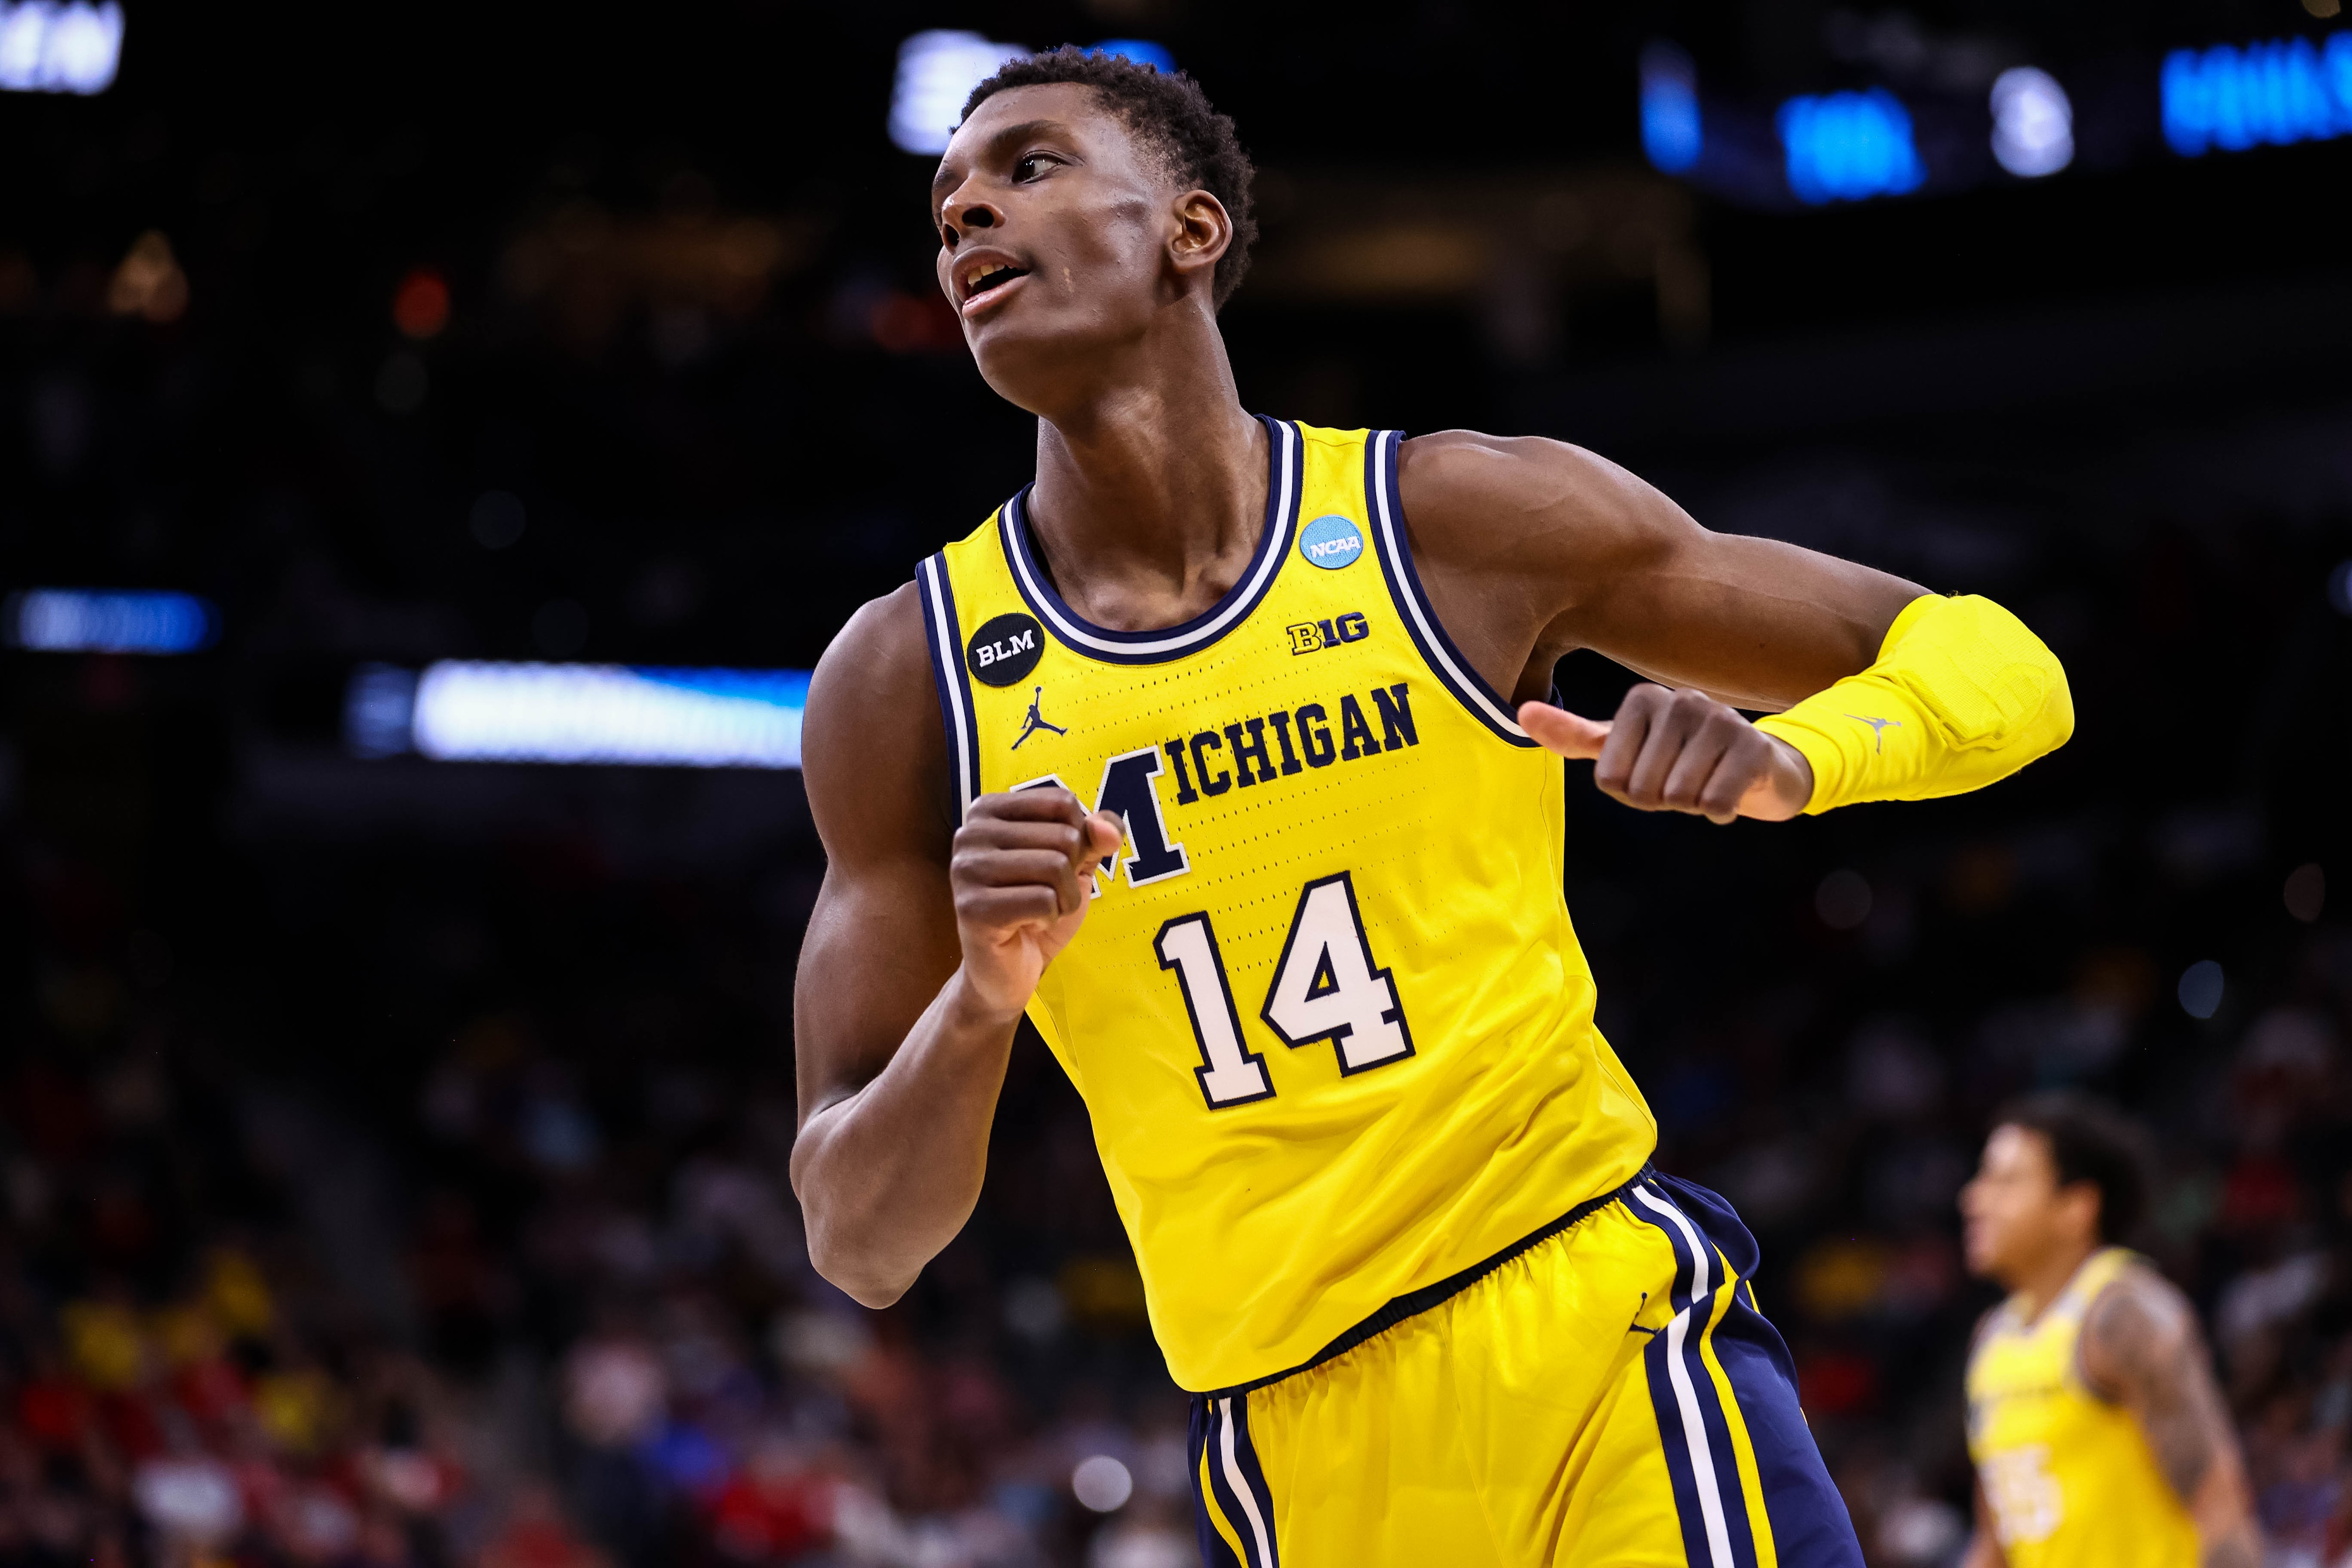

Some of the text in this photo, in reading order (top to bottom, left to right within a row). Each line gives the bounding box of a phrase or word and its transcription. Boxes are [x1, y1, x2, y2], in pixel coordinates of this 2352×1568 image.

[1310, 536, 1361, 558] NCAA
[976, 629, 1035, 668] BLM
[1152, 870, 1416, 1110] 14
